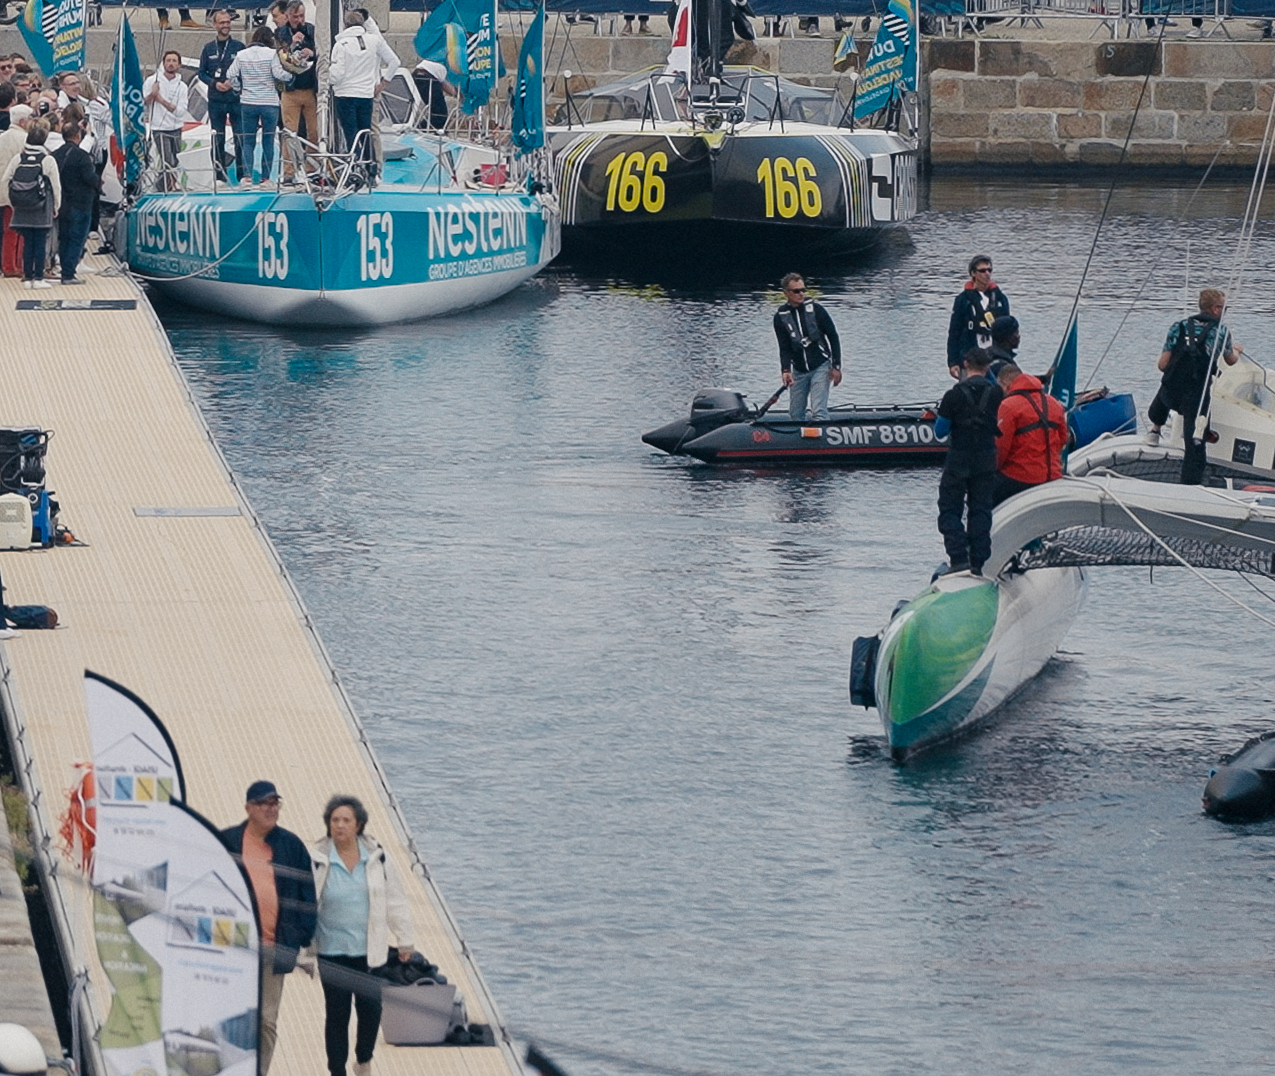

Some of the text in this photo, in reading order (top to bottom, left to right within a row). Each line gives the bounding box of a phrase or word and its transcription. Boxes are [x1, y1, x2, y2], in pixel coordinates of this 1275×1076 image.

[605, 151, 668, 214] 166
[757, 156, 823, 219] 166
[255, 212, 290, 281] 153
[356, 212, 394, 282] 153
[826, 425, 878, 445] SMF
